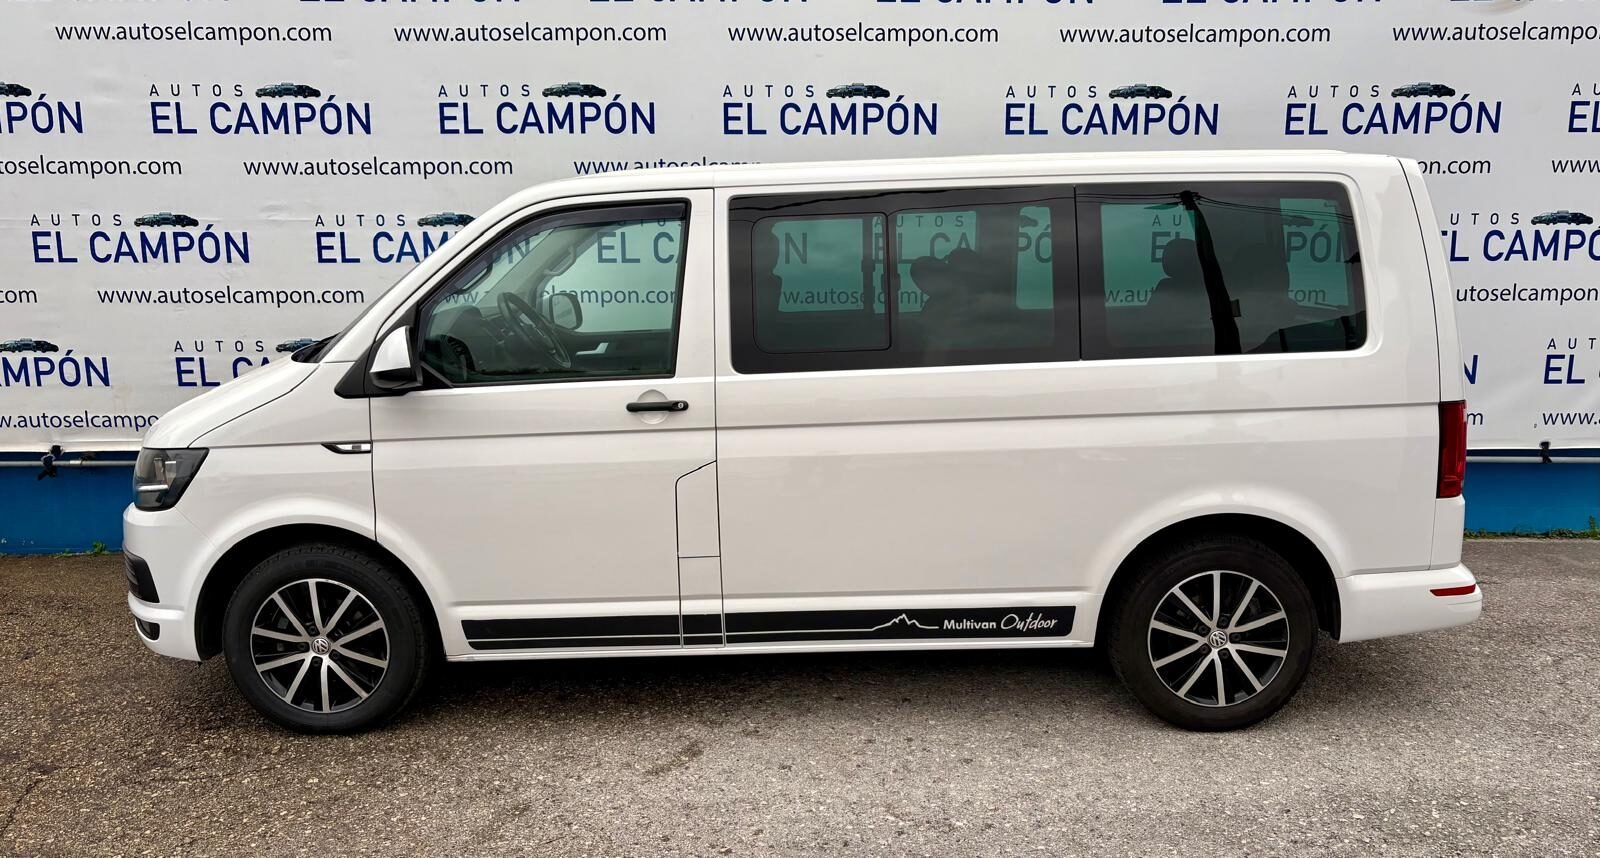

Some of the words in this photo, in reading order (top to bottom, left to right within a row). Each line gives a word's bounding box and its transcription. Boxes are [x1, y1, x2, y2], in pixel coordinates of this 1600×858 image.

[55, 21, 332, 46] www.autoselcampon.com
[394, 22, 667, 46] www.autoselcampon.com
[728, 22, 999, 47] www.autoselcampon.com
[1060, 23, 1331, 47] www.autoselcampon.com
[1393, 21, 1600, 45] www.autoselcampo
[150, 84, 243, 97] AUTOS
[438, 84, 530, 97] AUTOS
[723, 85, 815, 98] AUTOS
[1006, 85, 1097, 98] AUTOS
[1288, 85, 1380, 98] AUTOS
[0, 93, 83, 134] PÓN
[151, 102, 197, 134] EL
[209, 95, 371, 135] CAMPÓN
[439, 102, 483, 134] EL
[496, 94, 656, 135] CAMPÓN
[723, 103, 767, 135] EL
[780, 95, 938, 136] CAMPÓN
[1005, 103, 1048, 135] EL
[1061, 95, 1219, 136] CAMPÓN
[1285, 103, 1329, 136] EL
[1342, 93, 1502, 135] CAMPÓN
[244, 155, 513, 180] www.autoselcampon.com
[30, 213, 122, 227] AUTOS
[315, 214, 406, 227] AUTOS
[1450, 212, 1520, 226] UTOS
[32, 231, 78, 263] EL
[90, 224, 250, 264] CAMPÓN
[316, 232, 361, 264] EL
[97, 285, 365, 309] www.autoselcampon.com
[174, 340, 264, 353] AUTOS
[0, 349, 111, 388] MPÓN
[175, 356, 221, 387] EL
[1543, 354, 1586, 385] EL
[1542, 412, 1600, 426] www.
[943, 619, 997, 630] Multivan
[1000, 612, 1058, 632] Outdoor
